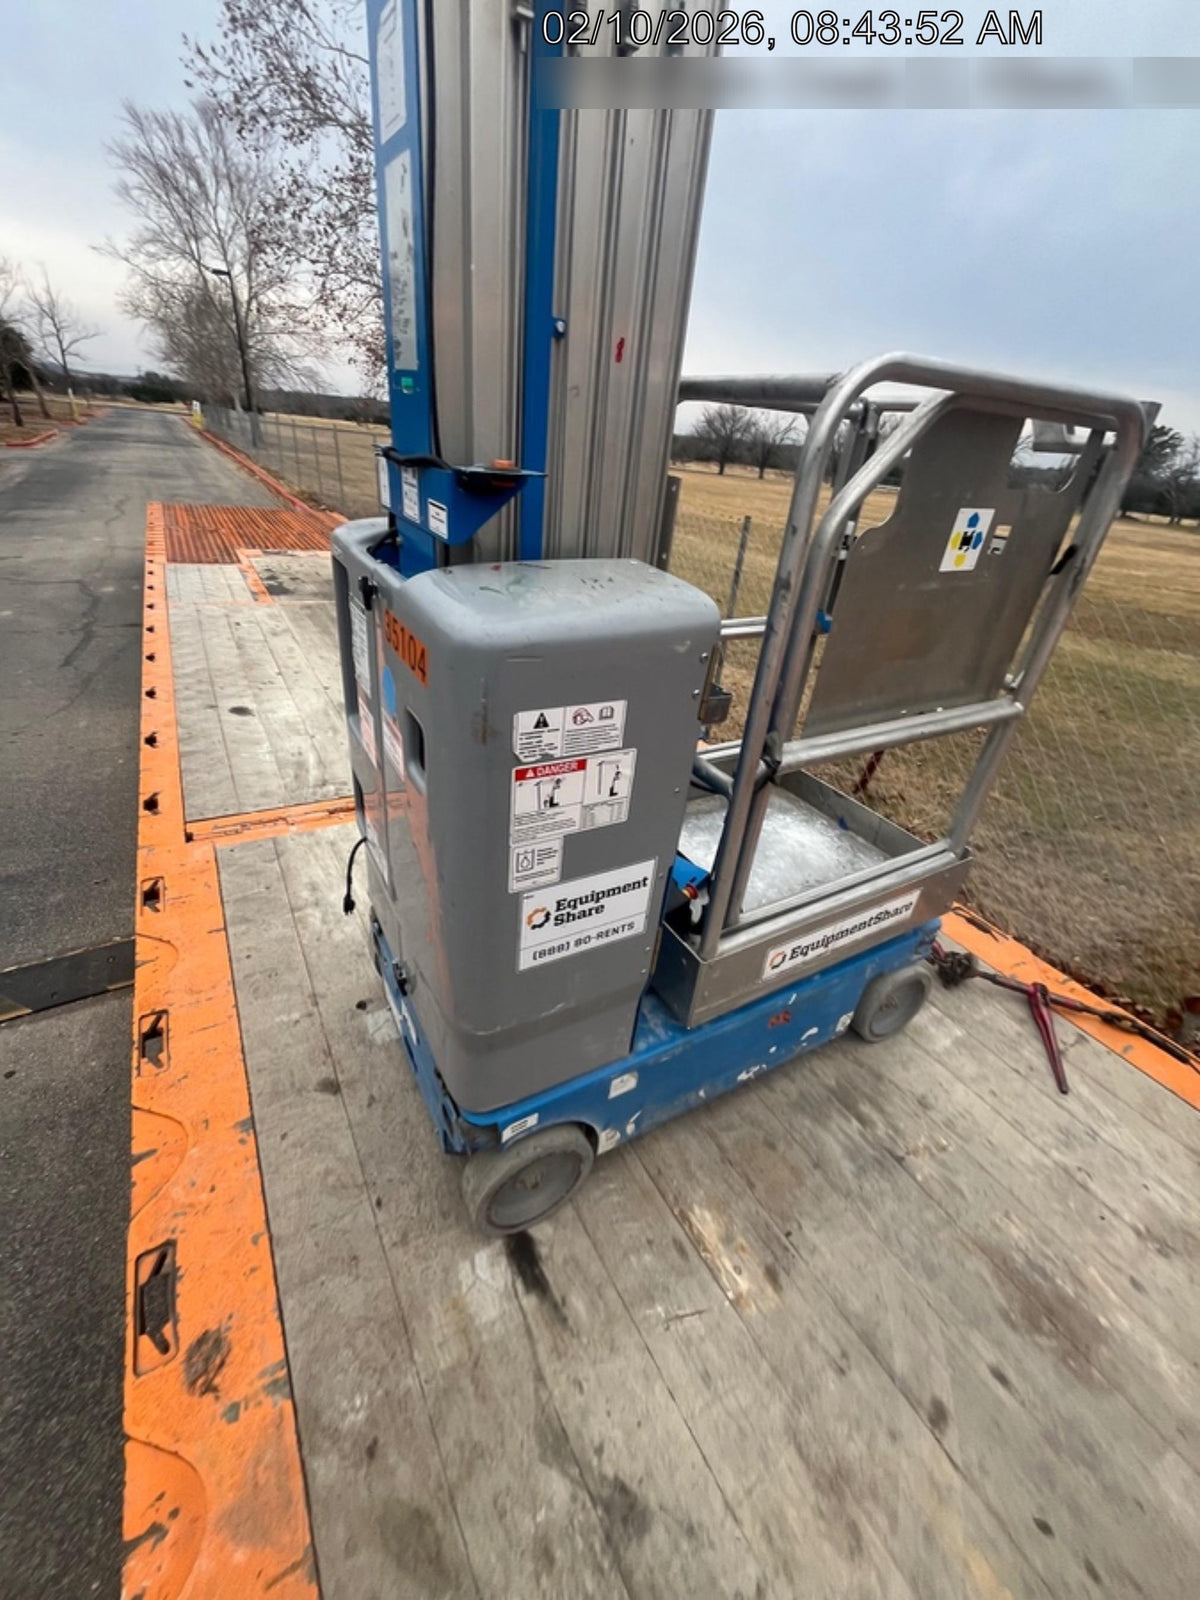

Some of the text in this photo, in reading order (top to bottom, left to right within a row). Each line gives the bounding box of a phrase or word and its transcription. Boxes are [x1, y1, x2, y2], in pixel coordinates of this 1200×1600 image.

[536, 762, 579, 777] DANGER
[554, 876, 649, 912] Equipment
[553, 903, 605, 927] Share
[788, 901, 913, 960] EquipmentShare
